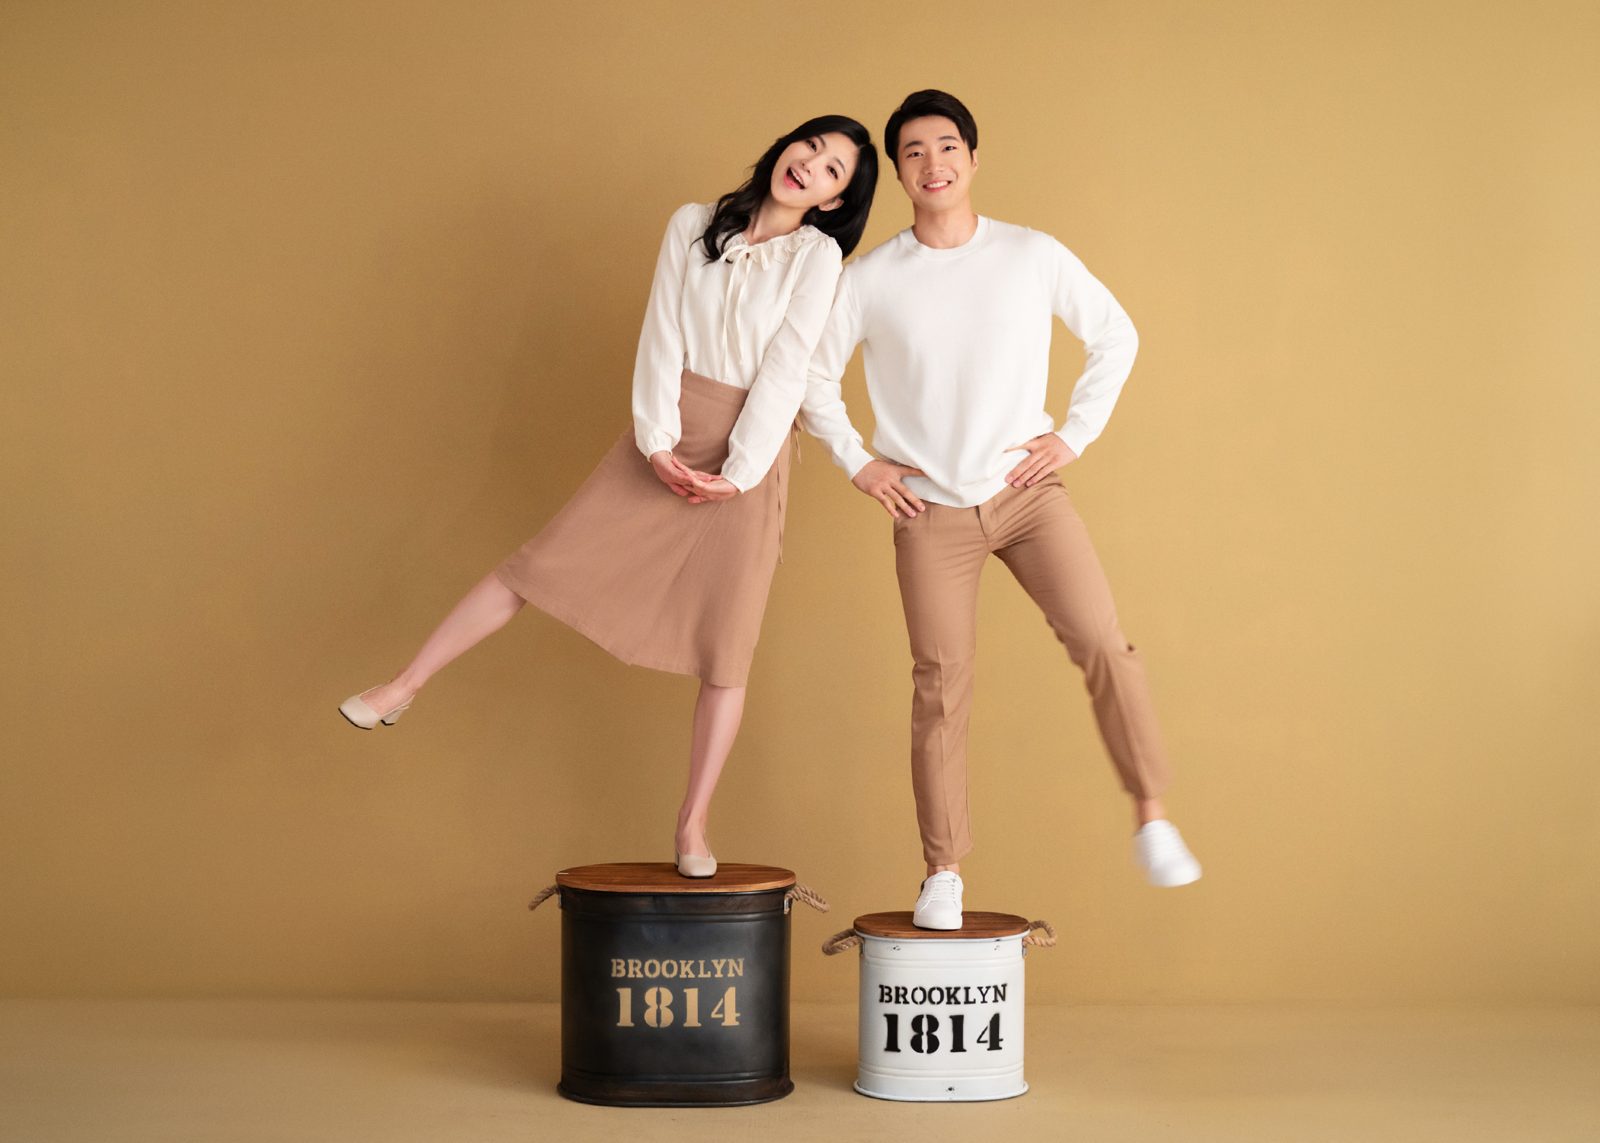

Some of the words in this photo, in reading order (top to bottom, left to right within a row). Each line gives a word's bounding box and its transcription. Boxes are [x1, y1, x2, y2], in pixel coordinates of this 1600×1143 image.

[611, 957, 745, 980] BROOKLYN
[616, 986, 741, 1028] 1814
[878, 983, 1008, 1006] BROOKLYN
[882, 1013, 1004, 1055] 1814
